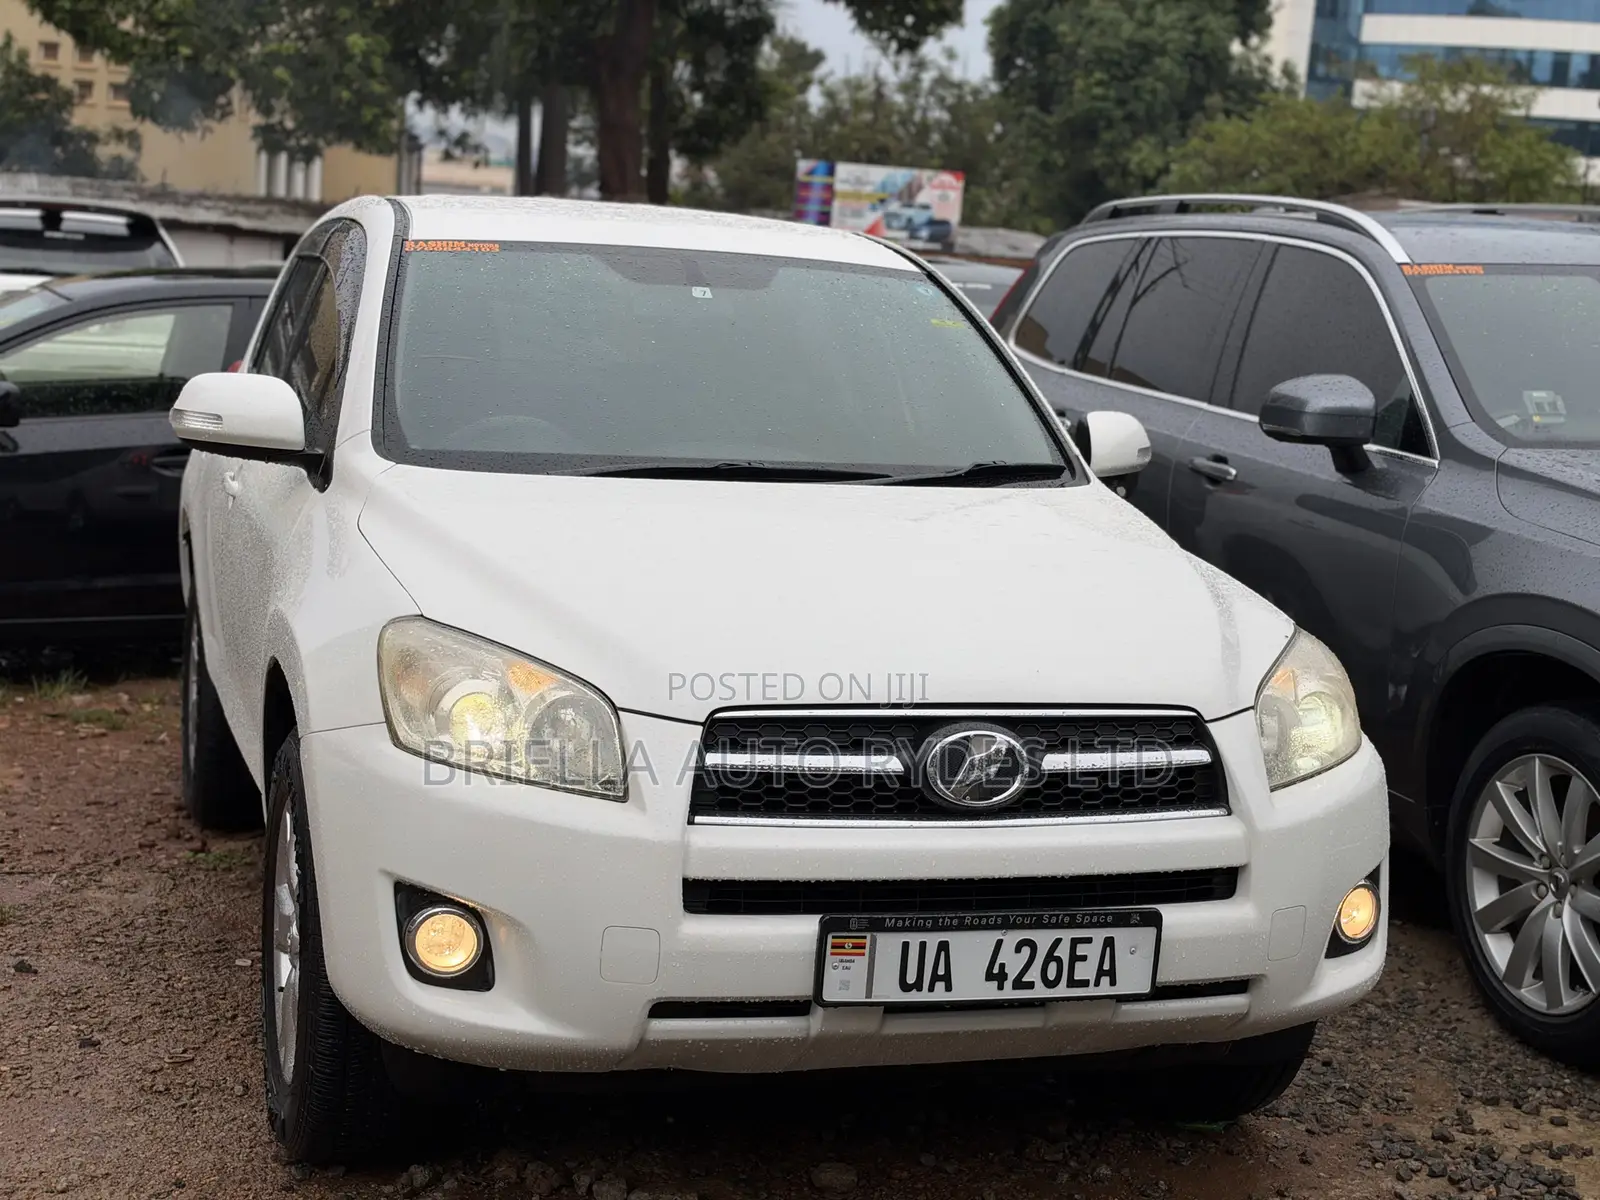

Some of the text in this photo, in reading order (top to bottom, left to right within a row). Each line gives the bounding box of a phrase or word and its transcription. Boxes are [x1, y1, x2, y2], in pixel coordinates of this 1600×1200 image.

[884, 913, 1114, 929] Making the Roads Your Safe Space
[898, 935, 1118, 993] UA 426EA
